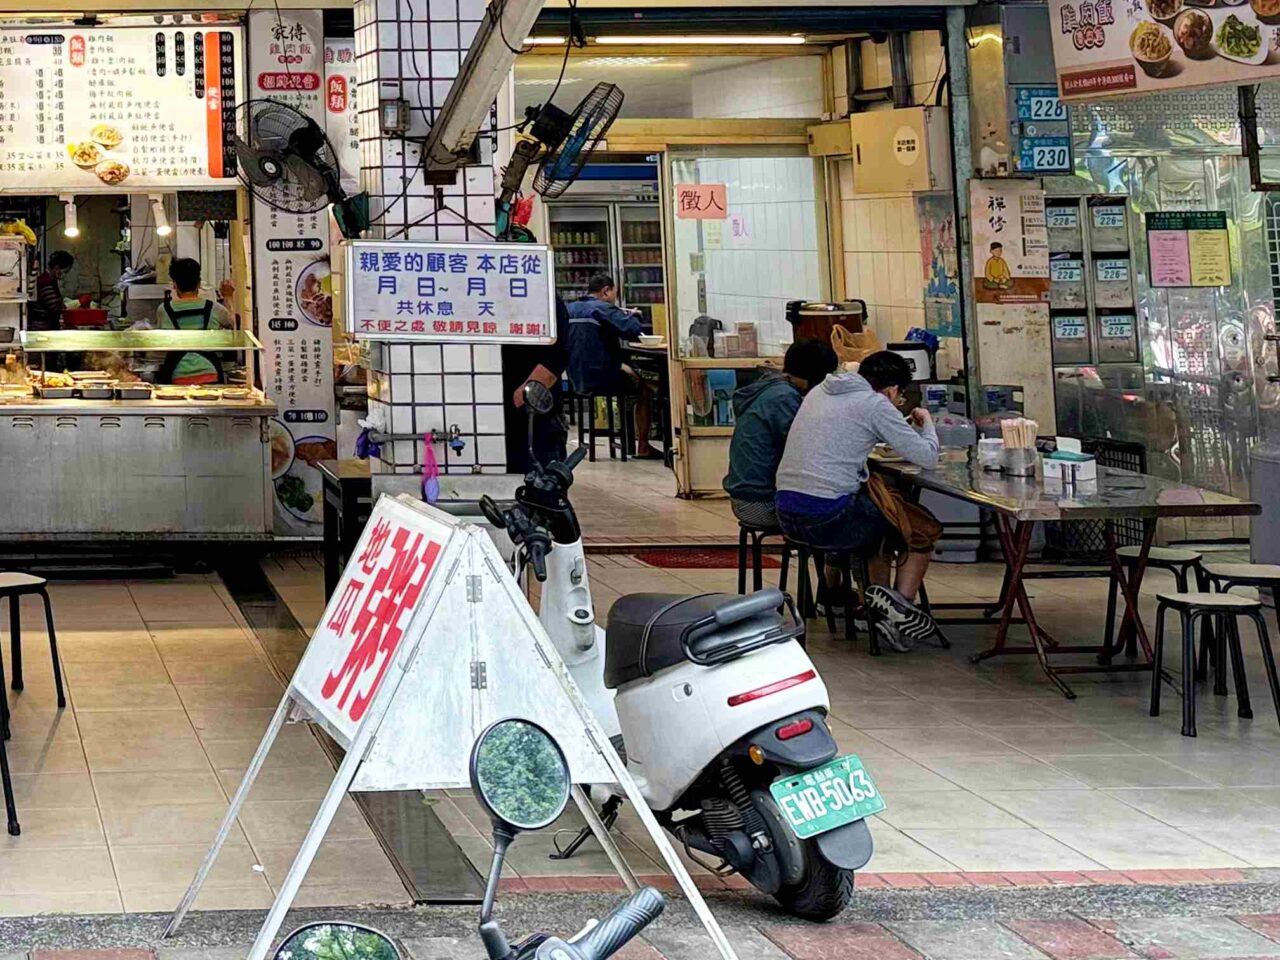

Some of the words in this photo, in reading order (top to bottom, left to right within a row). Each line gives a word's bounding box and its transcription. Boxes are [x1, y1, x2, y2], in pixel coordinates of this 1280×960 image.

[271, 22, 307, 41] 家傳
[270, 43, 311, 54] 雞肉飯
[324, 47, 356, 64] 自助
[330, 80, 343, 108] 飯類
[1034, 100, 1062, 117] 228
[1037, 149, 1066, 166] 230
[680, 190, 724, 212] 徵人
[988, 196, 1007, 233] 禪修
[296, 241, 305, 249] 85
[311, 240, 320, 248] 90
[360, 251, 468, 273] 親愛的顧客
[477, 254, 541, 274] 本店從
[377, 276, 397, 295] 月
[467, 277, 486, 296] 月
[510, 278, 528, 298] 日
[396, 301, 454, 316] 共休息
[478, 301, 495, 316] 天
[360, 320, 425, 332] 不便之處
[432, 320, 498, 334] 敬請見諒
[509, 323, 546, 336] 謝謝!
[327, 517, 391, 638] 地瓜
[321, 527, 441, 722] 粥
[781, 770, 876, 826] EWB-5063
